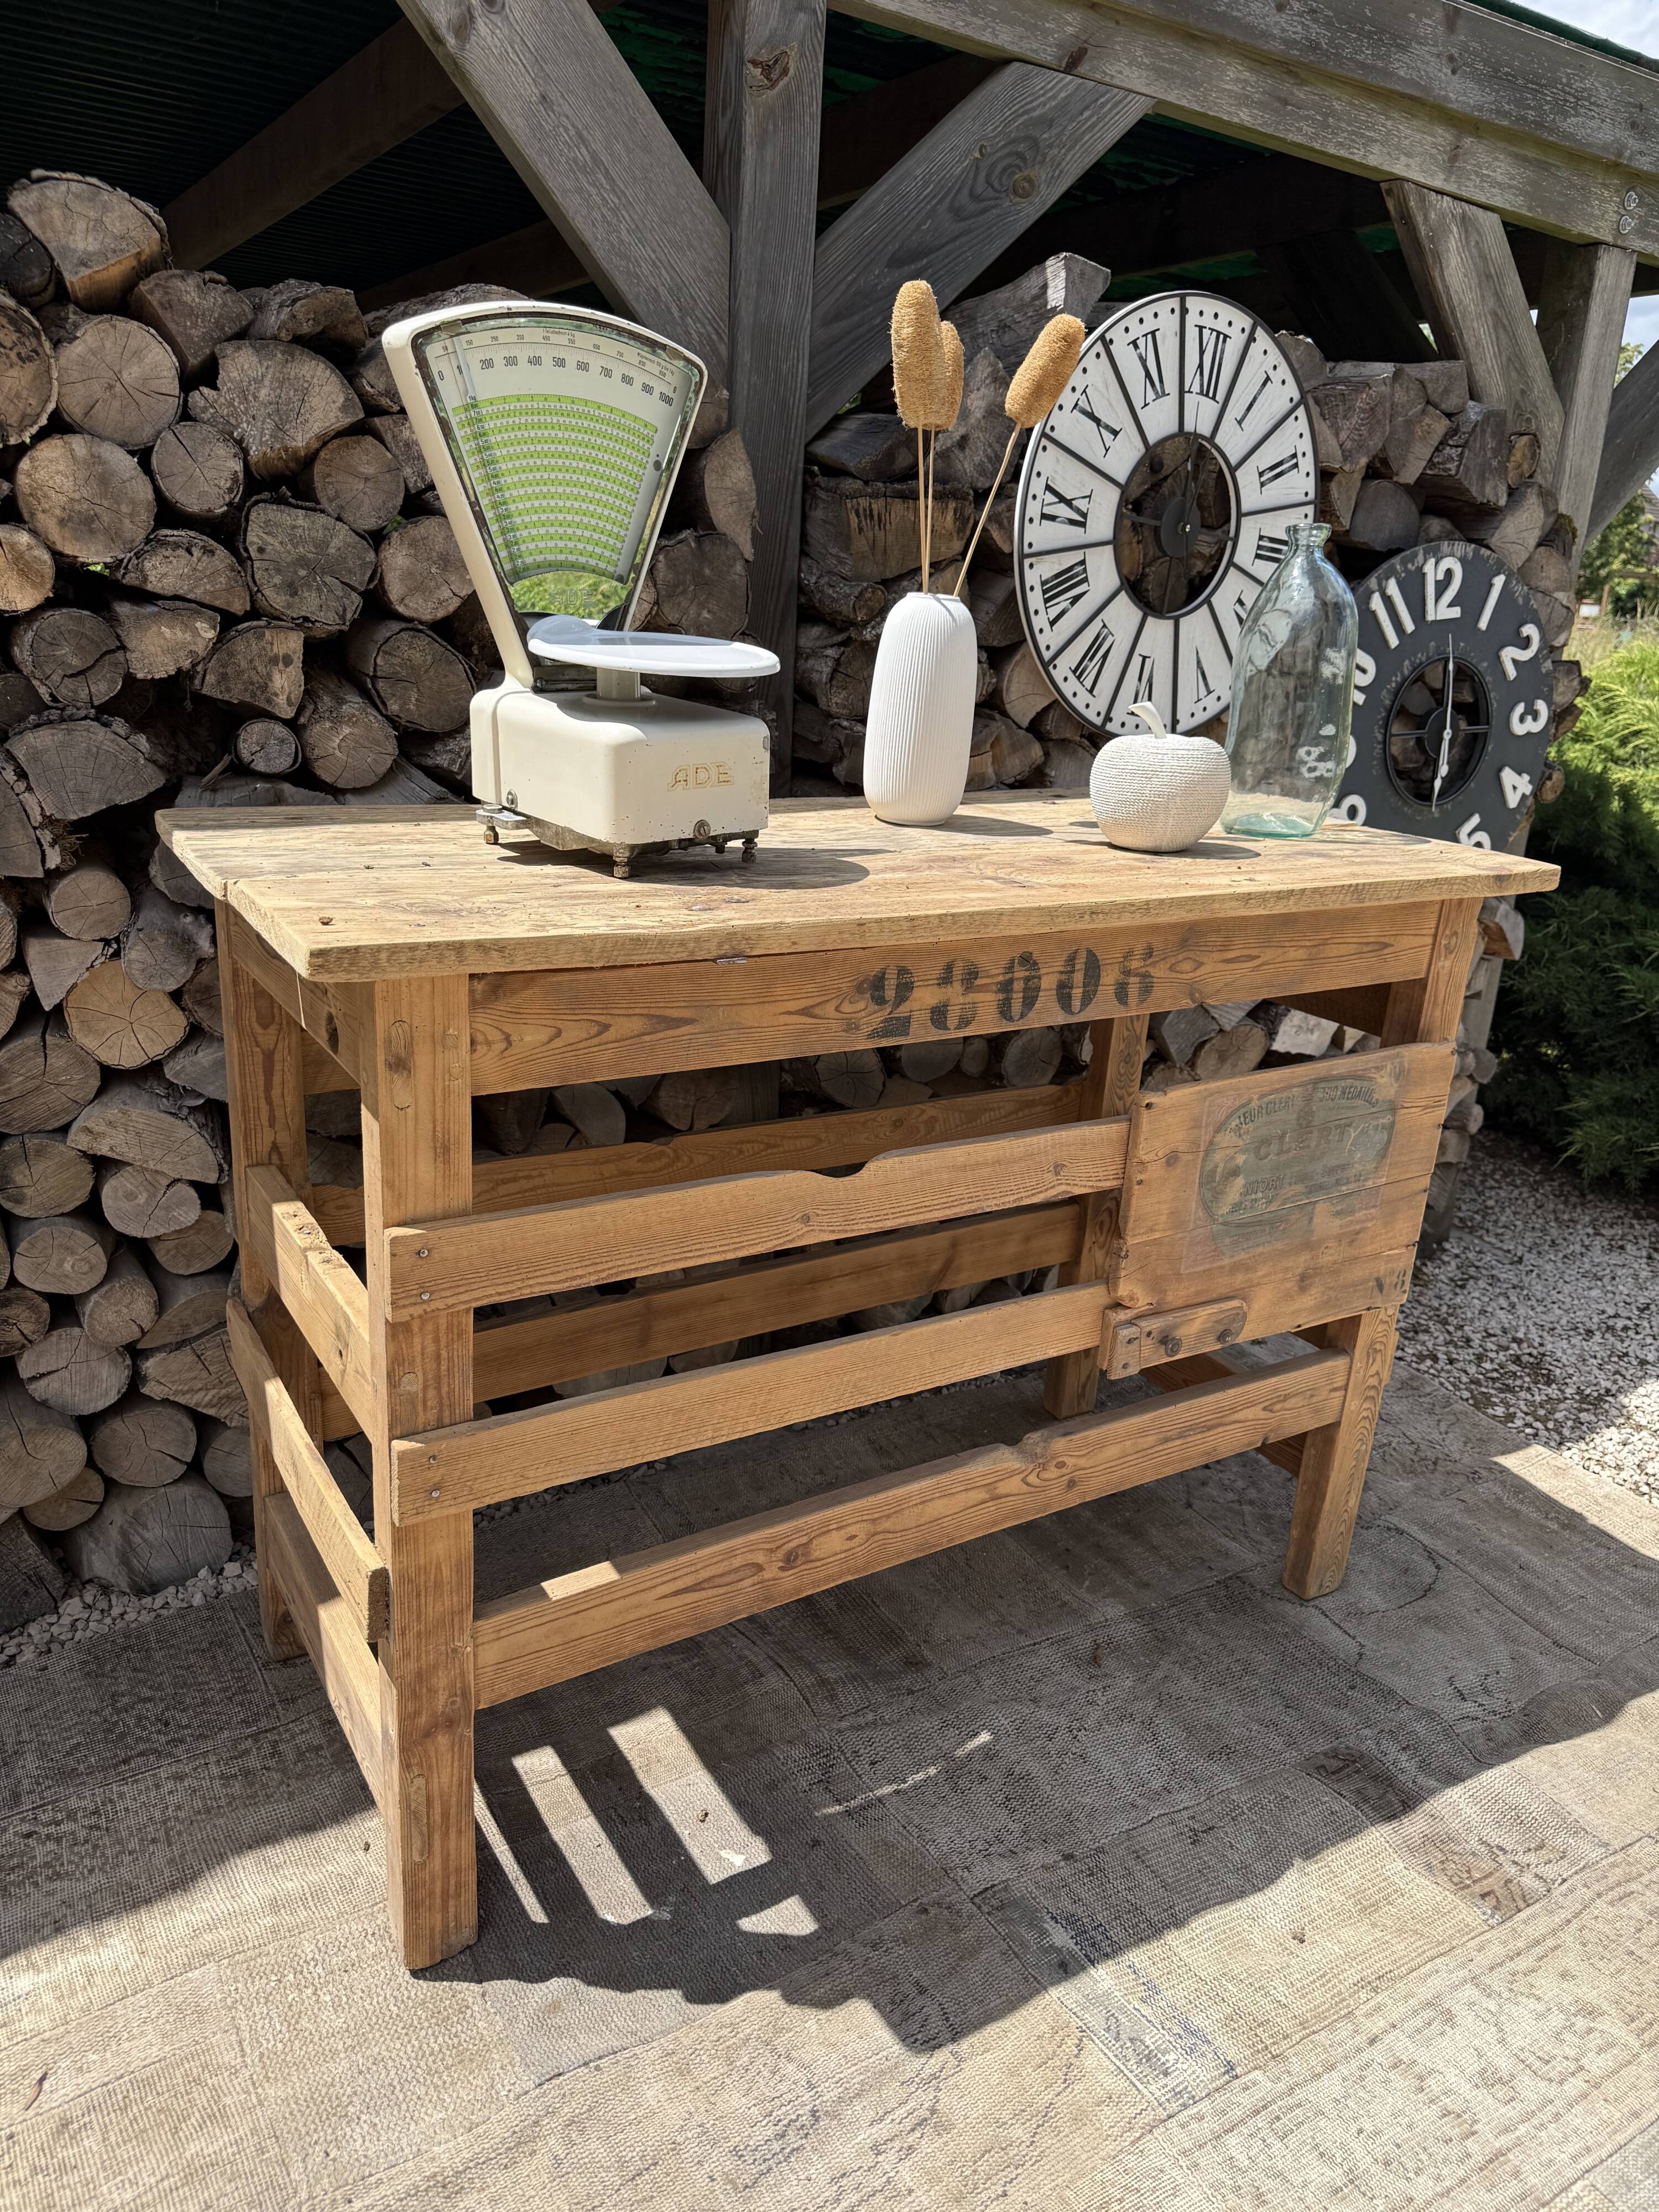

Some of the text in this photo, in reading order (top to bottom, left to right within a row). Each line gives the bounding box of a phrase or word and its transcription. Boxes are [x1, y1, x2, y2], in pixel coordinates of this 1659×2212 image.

[437, 356, 674, 406] 0 200 300 400 500 600 700 800 900 1000
[1127, 328, 1170, 409] XI
[1185, 324, 1232, 403] XII
[1071, 384, 1122, 458] X
[1235, 371, 1273, 431] I
[1257, 445, 1300, 495] II
[1040, 476, 1093, 534] IX
[1040, 551, 1091, 632] VIII
[1369, 576, 1415, 649] 11
[1422, 556, 1463, 622] 12
[1477, 574, 1505, 632] 1
[1069, 619, 1115, 697] VII
[1194, 646, 1215, 703] V
[1498, 623, 1540, 681] 2
[1509, 699, 1548, 735] 3
[667, 762, 734, 791] ADE
[1499, 766, 1533, 809] 4
